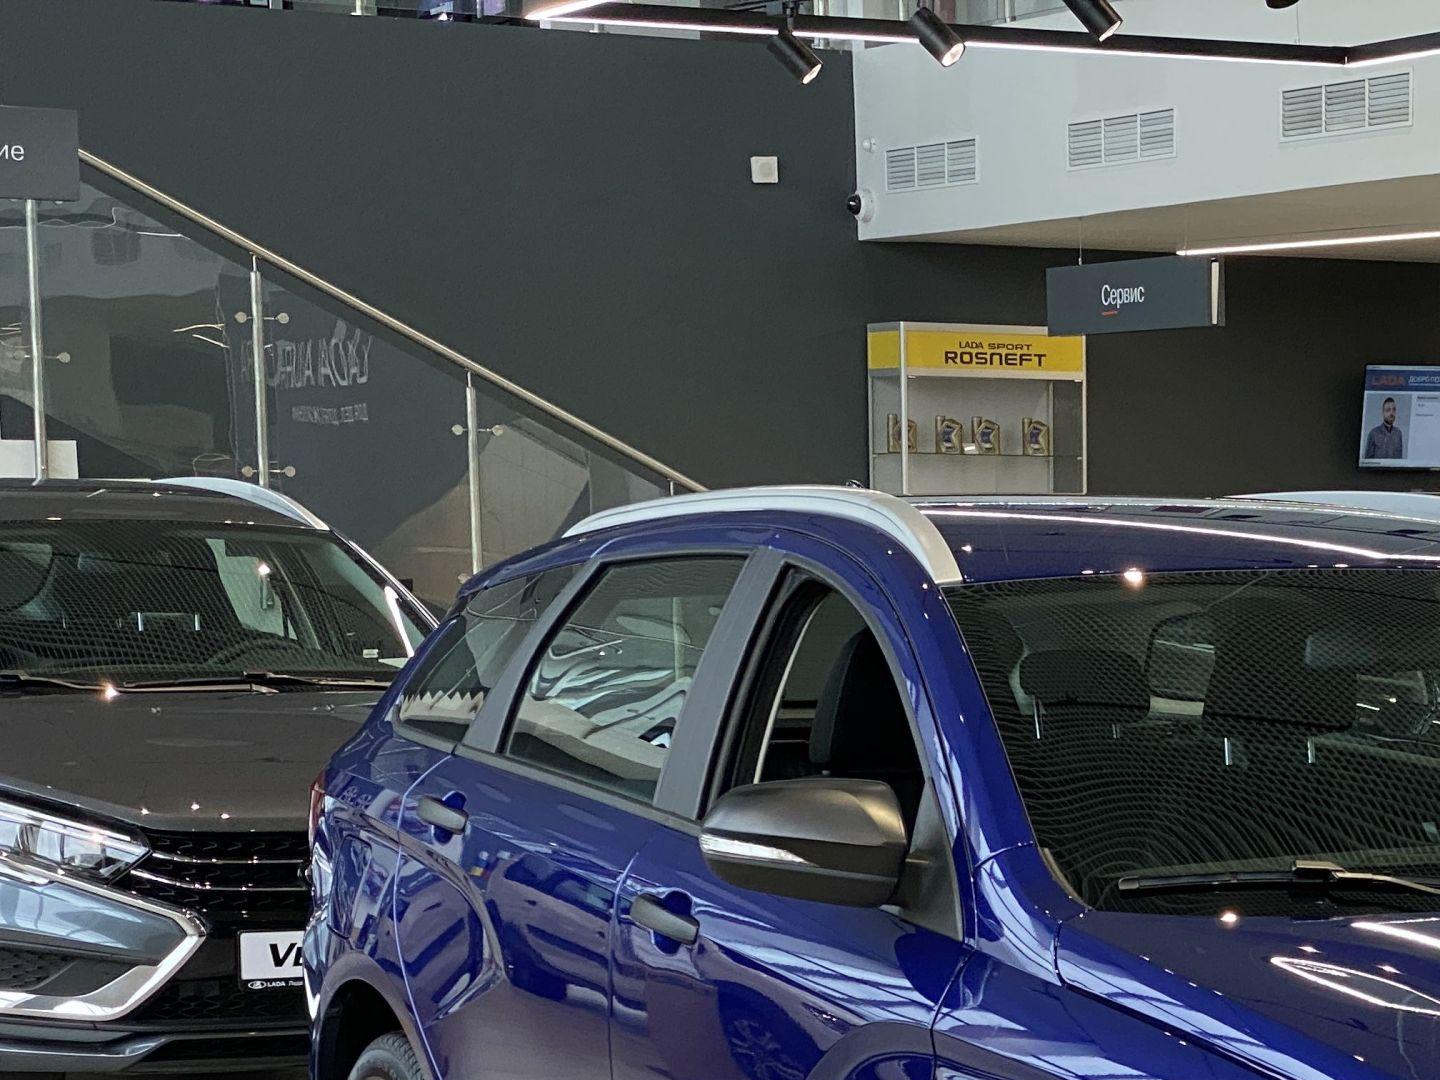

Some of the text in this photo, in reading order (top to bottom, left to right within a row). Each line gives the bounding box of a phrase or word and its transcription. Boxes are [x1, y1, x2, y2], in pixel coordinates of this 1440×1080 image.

[1101, 284, 1145, 309] Сервис
[958, 340, 1033, 351] LADA SPORT
[944, 351, 1047, 367] ROSNEFT
